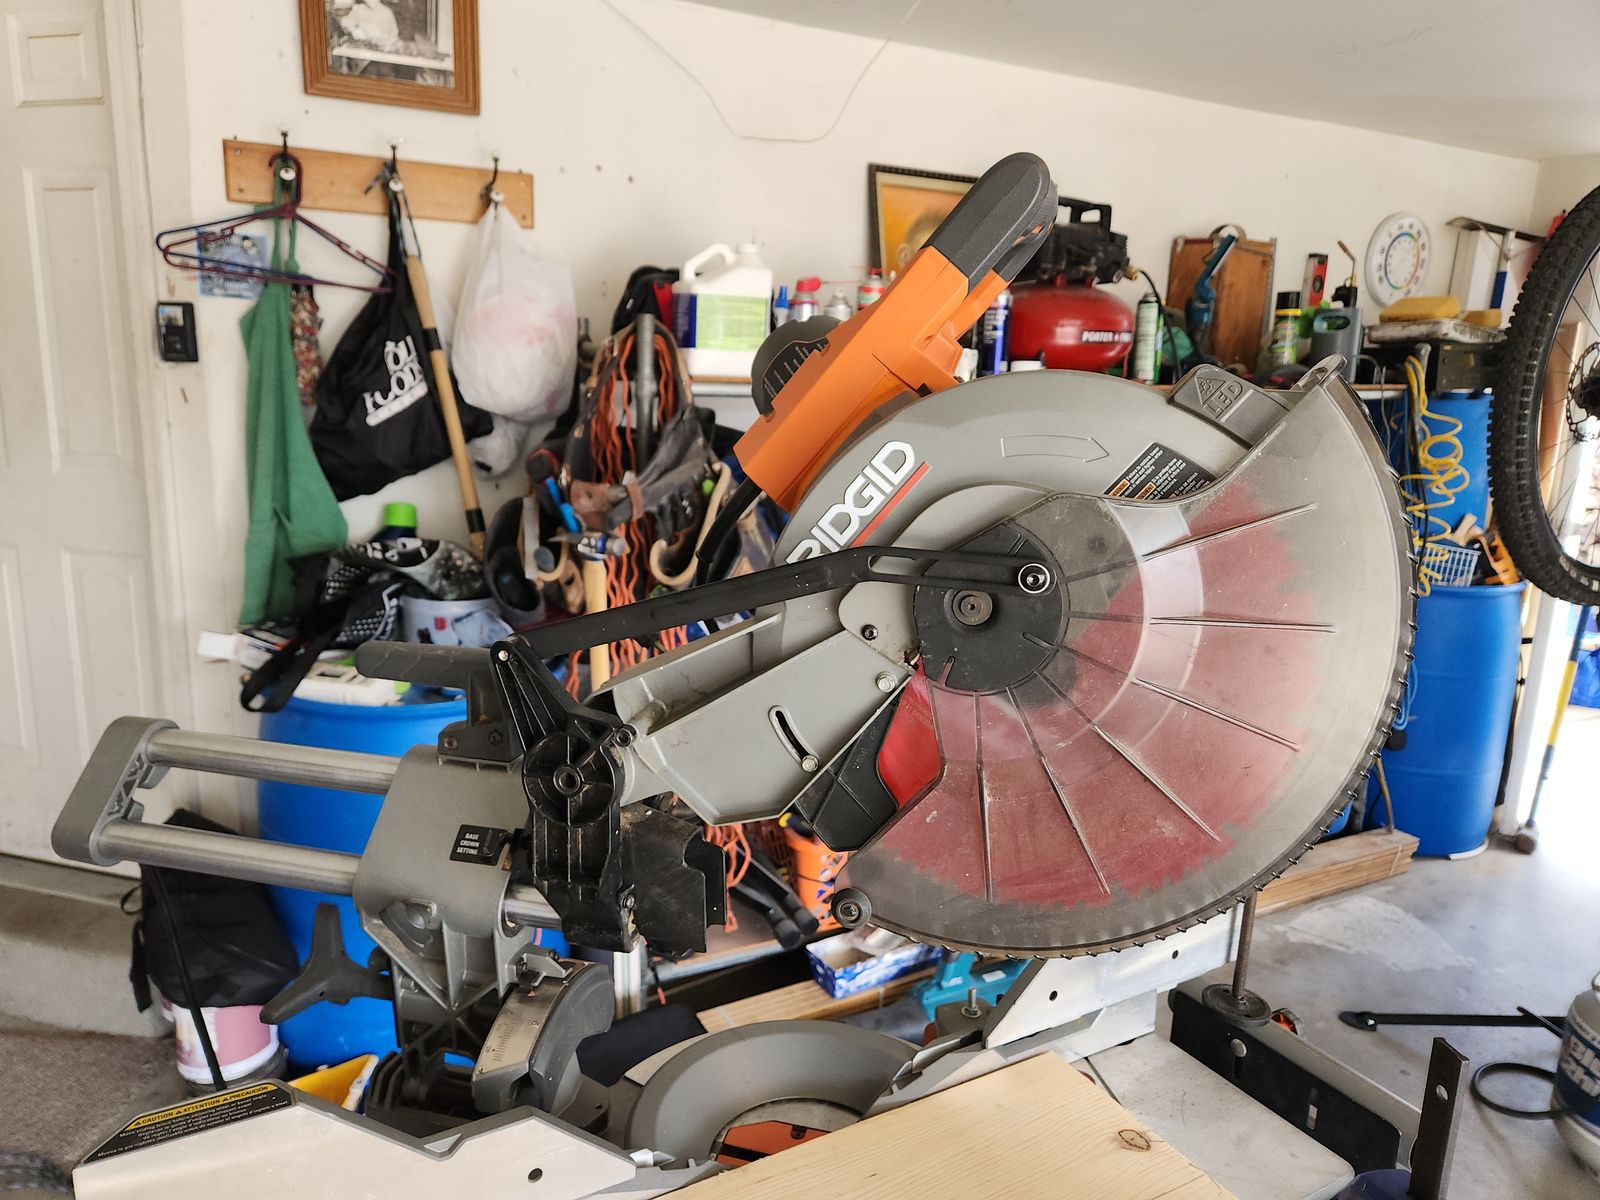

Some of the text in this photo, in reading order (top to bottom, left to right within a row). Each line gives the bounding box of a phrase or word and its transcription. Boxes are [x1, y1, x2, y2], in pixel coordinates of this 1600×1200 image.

[1202, 380, 1243, 419] LED
[456, 847, 478, 855] SETTING
[142, 1112, 174, 1124] CAUTION
[182, 1100, 221, 1113] ATTENTION
